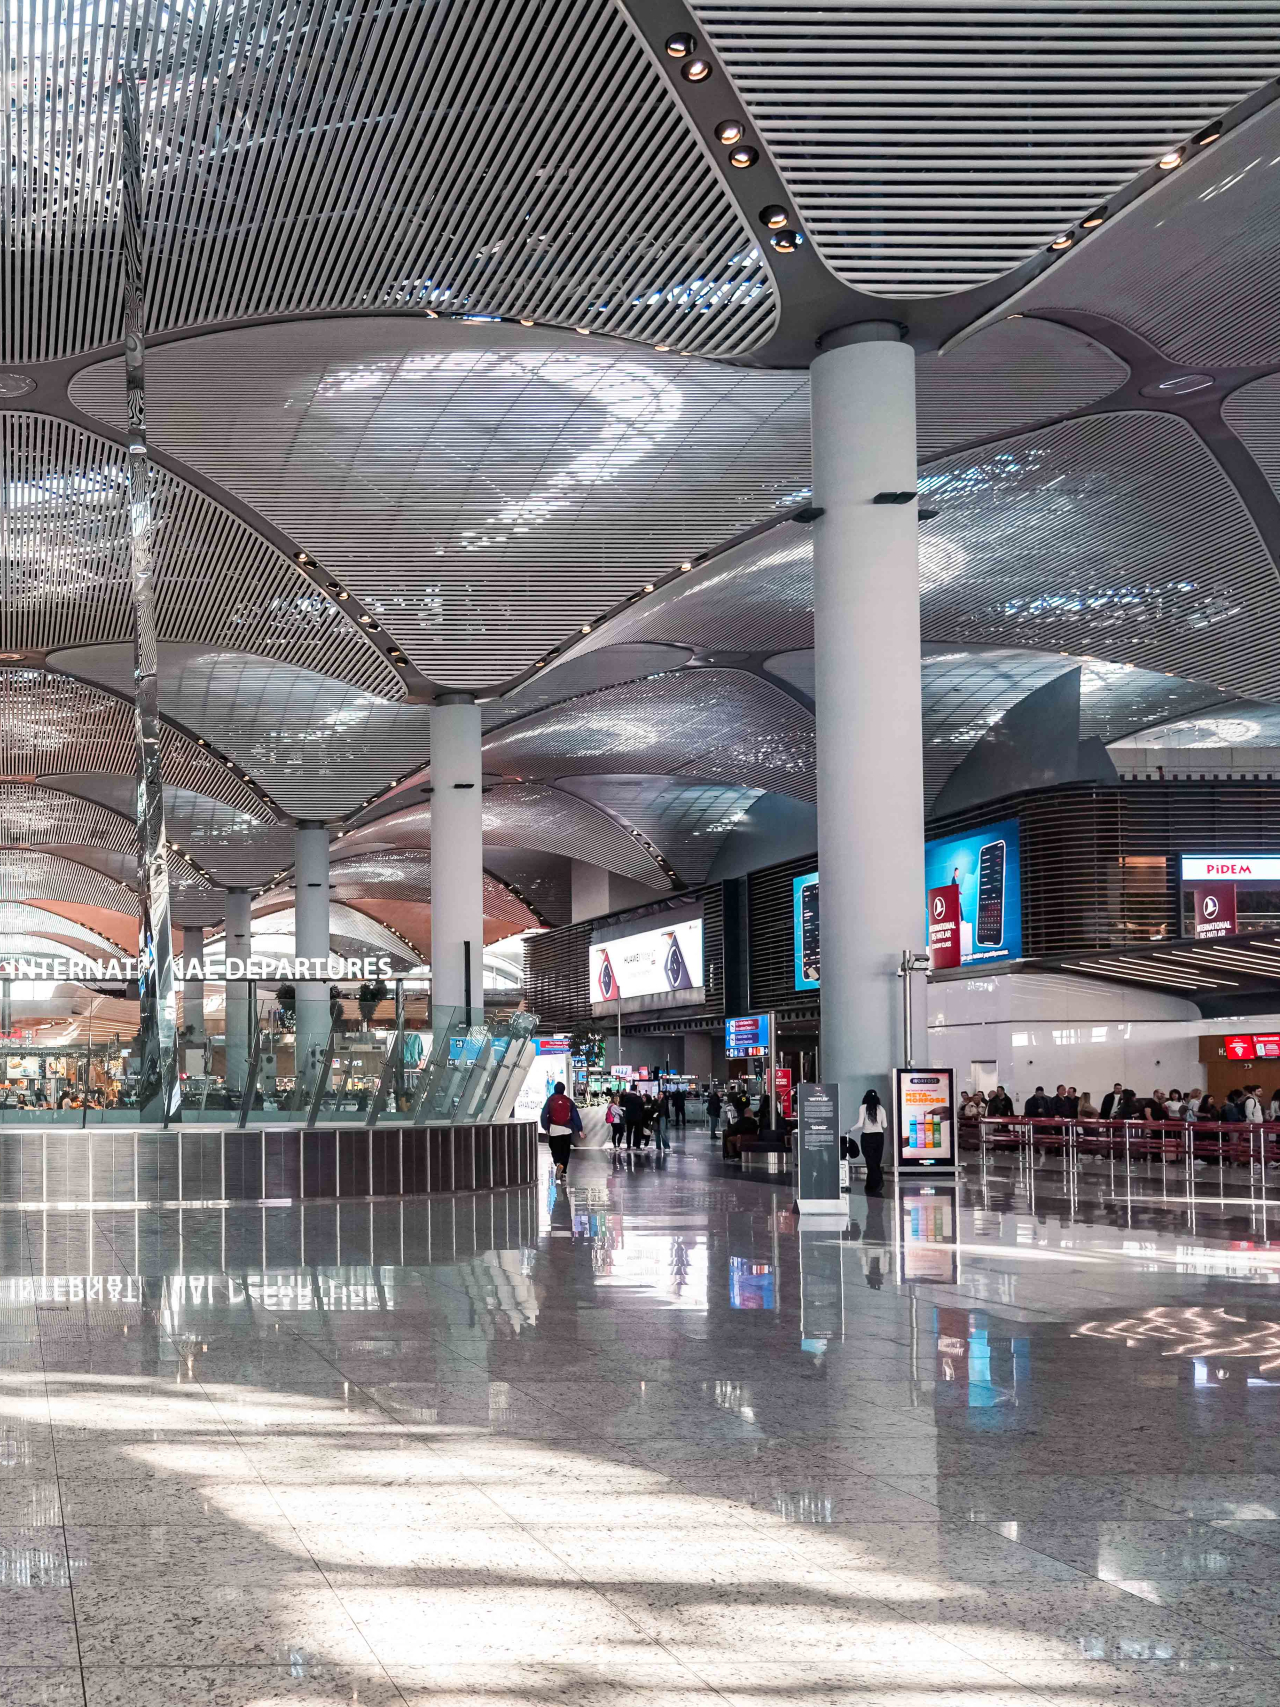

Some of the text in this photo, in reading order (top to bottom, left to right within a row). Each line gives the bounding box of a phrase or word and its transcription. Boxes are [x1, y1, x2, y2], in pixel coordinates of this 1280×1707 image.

[1207, 864, 1252, 874] PiDEM
[10, 957, 393, 980] INTERNATINAL DEPARTURES
